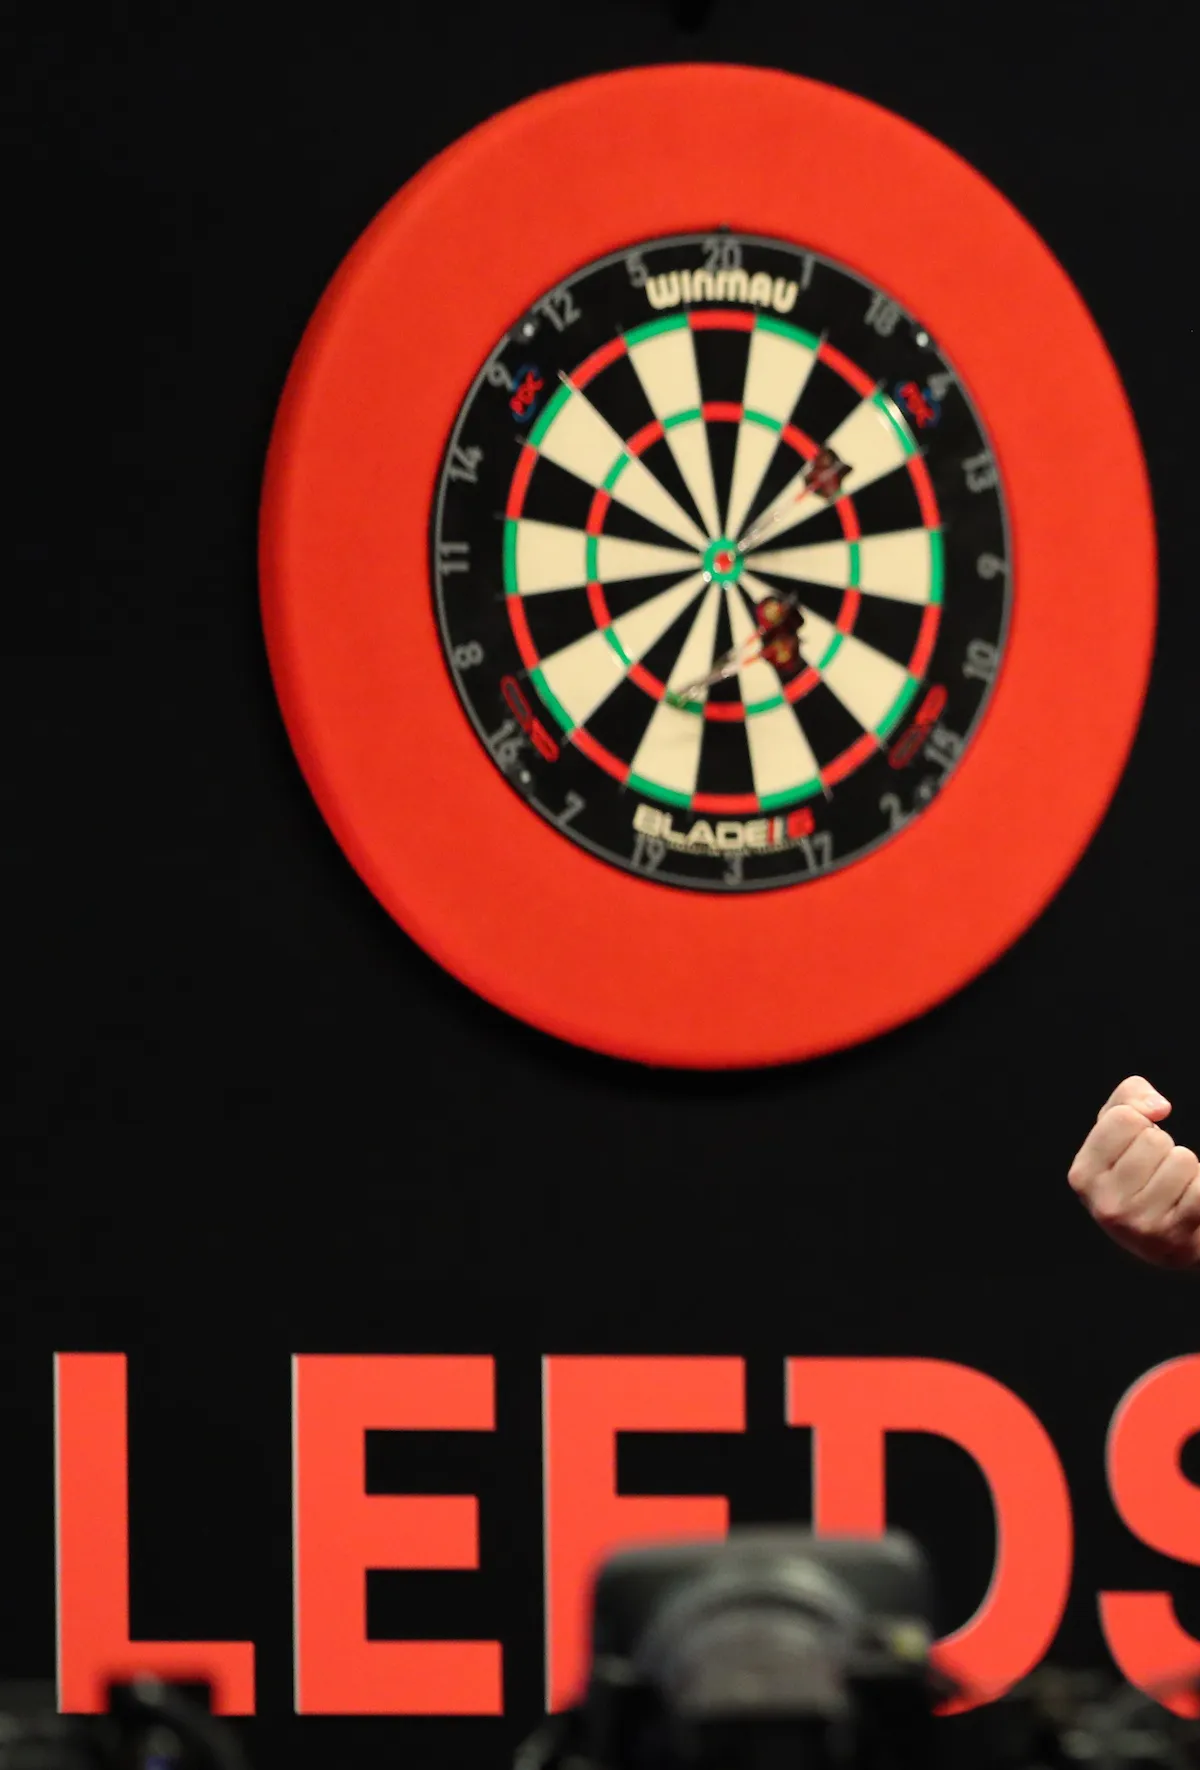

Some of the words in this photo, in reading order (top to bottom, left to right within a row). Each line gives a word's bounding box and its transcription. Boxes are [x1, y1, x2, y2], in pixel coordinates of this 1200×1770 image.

[623, 252, 650, 289] 5
[700, 238, 744, 272] 20
[801, 254, 817, 290] 1
[541, 284, 583, 333] 12
[450, 444, 485, 485] 14
[439, 540, 472, 577] 11
[451, 639, 486, 672] 8
[961, 636, 1000, 684] 10
[553, 788, 588, 829] 7
[877, 791, 911, 831] 2
